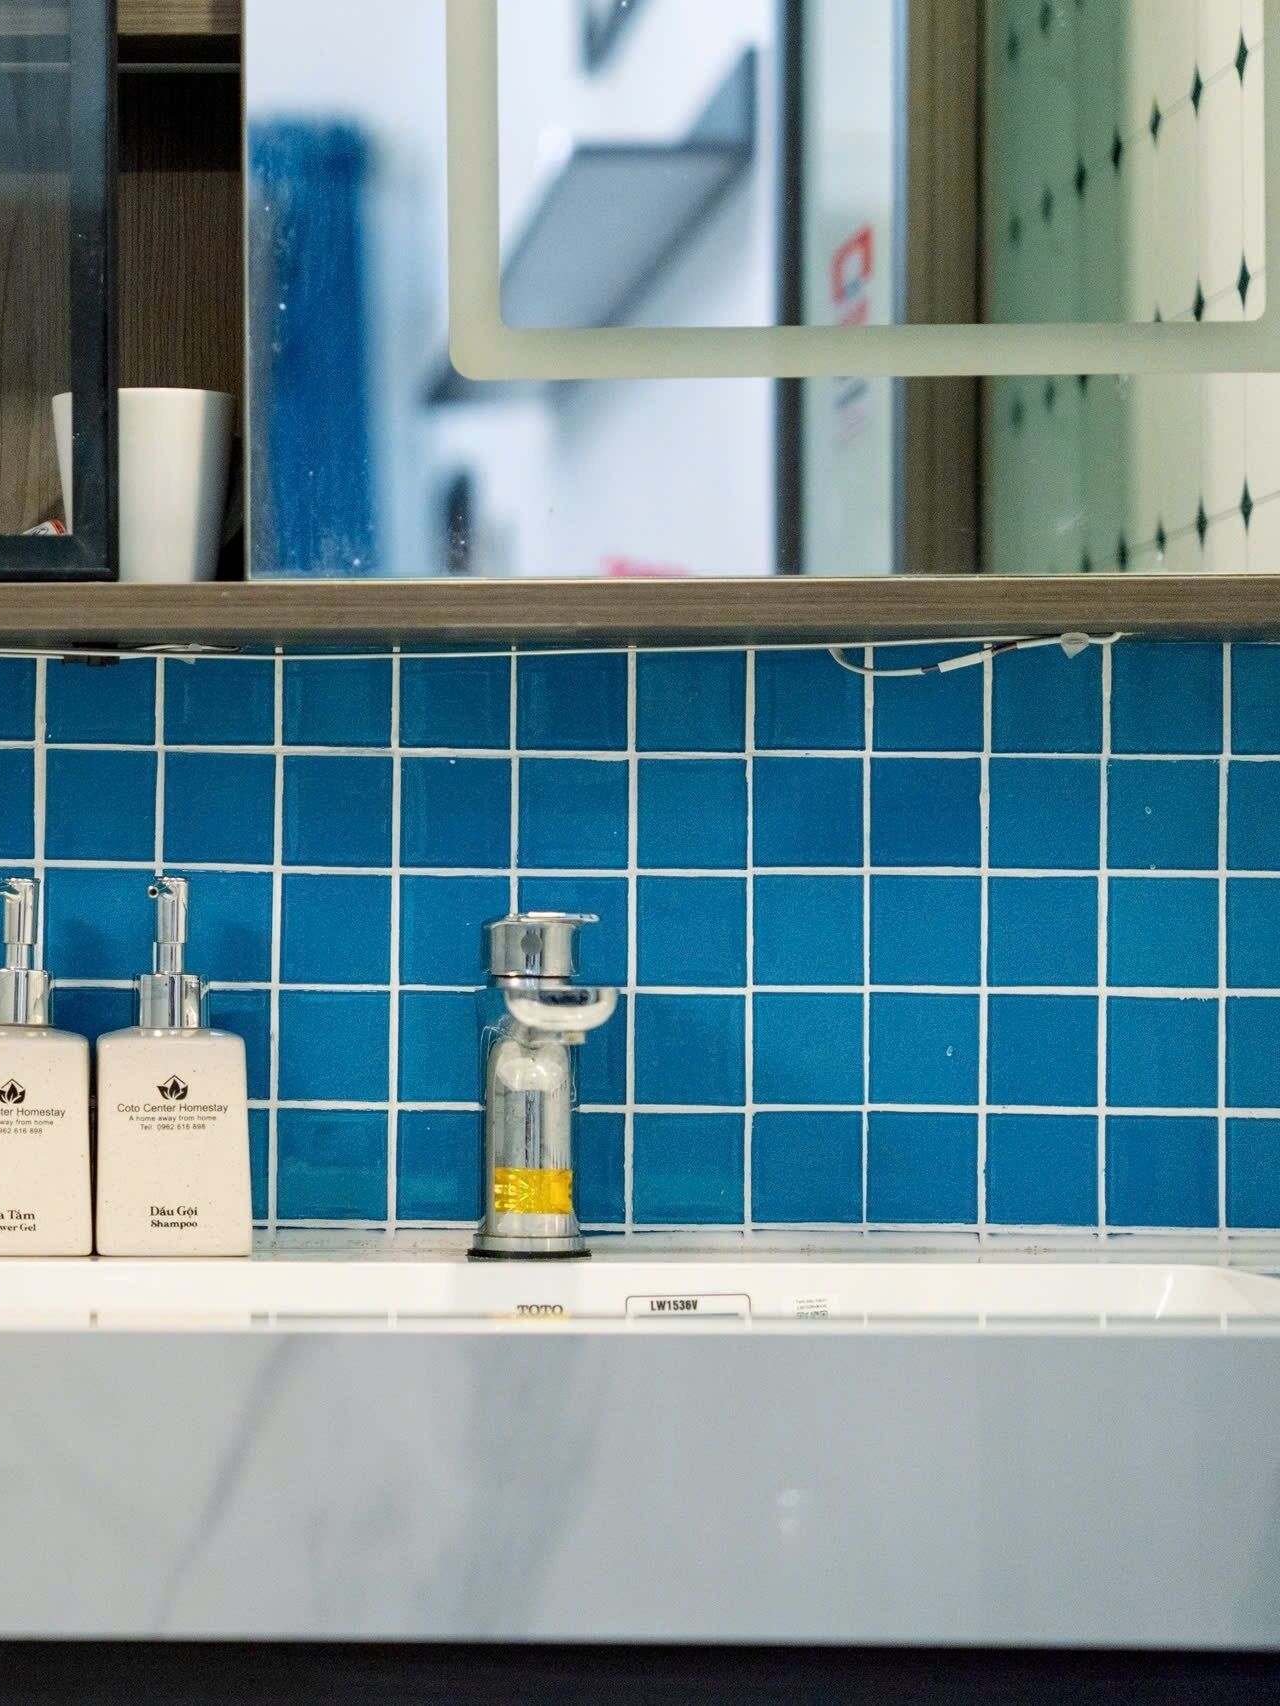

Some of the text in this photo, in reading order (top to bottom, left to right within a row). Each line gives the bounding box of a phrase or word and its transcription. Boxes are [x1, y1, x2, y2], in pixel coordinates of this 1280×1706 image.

[16, 1107, 66, 1118] Homestay
[117, 1103, 229, 1115] Coto Center Homestay
[19, 1223, 36, 1231] Gel
[150, 1219, 198, 1229] Shampoo
[517, 1304, 564, 1315] TOTO
[650, 1300, 698, 1311] LW1536V
